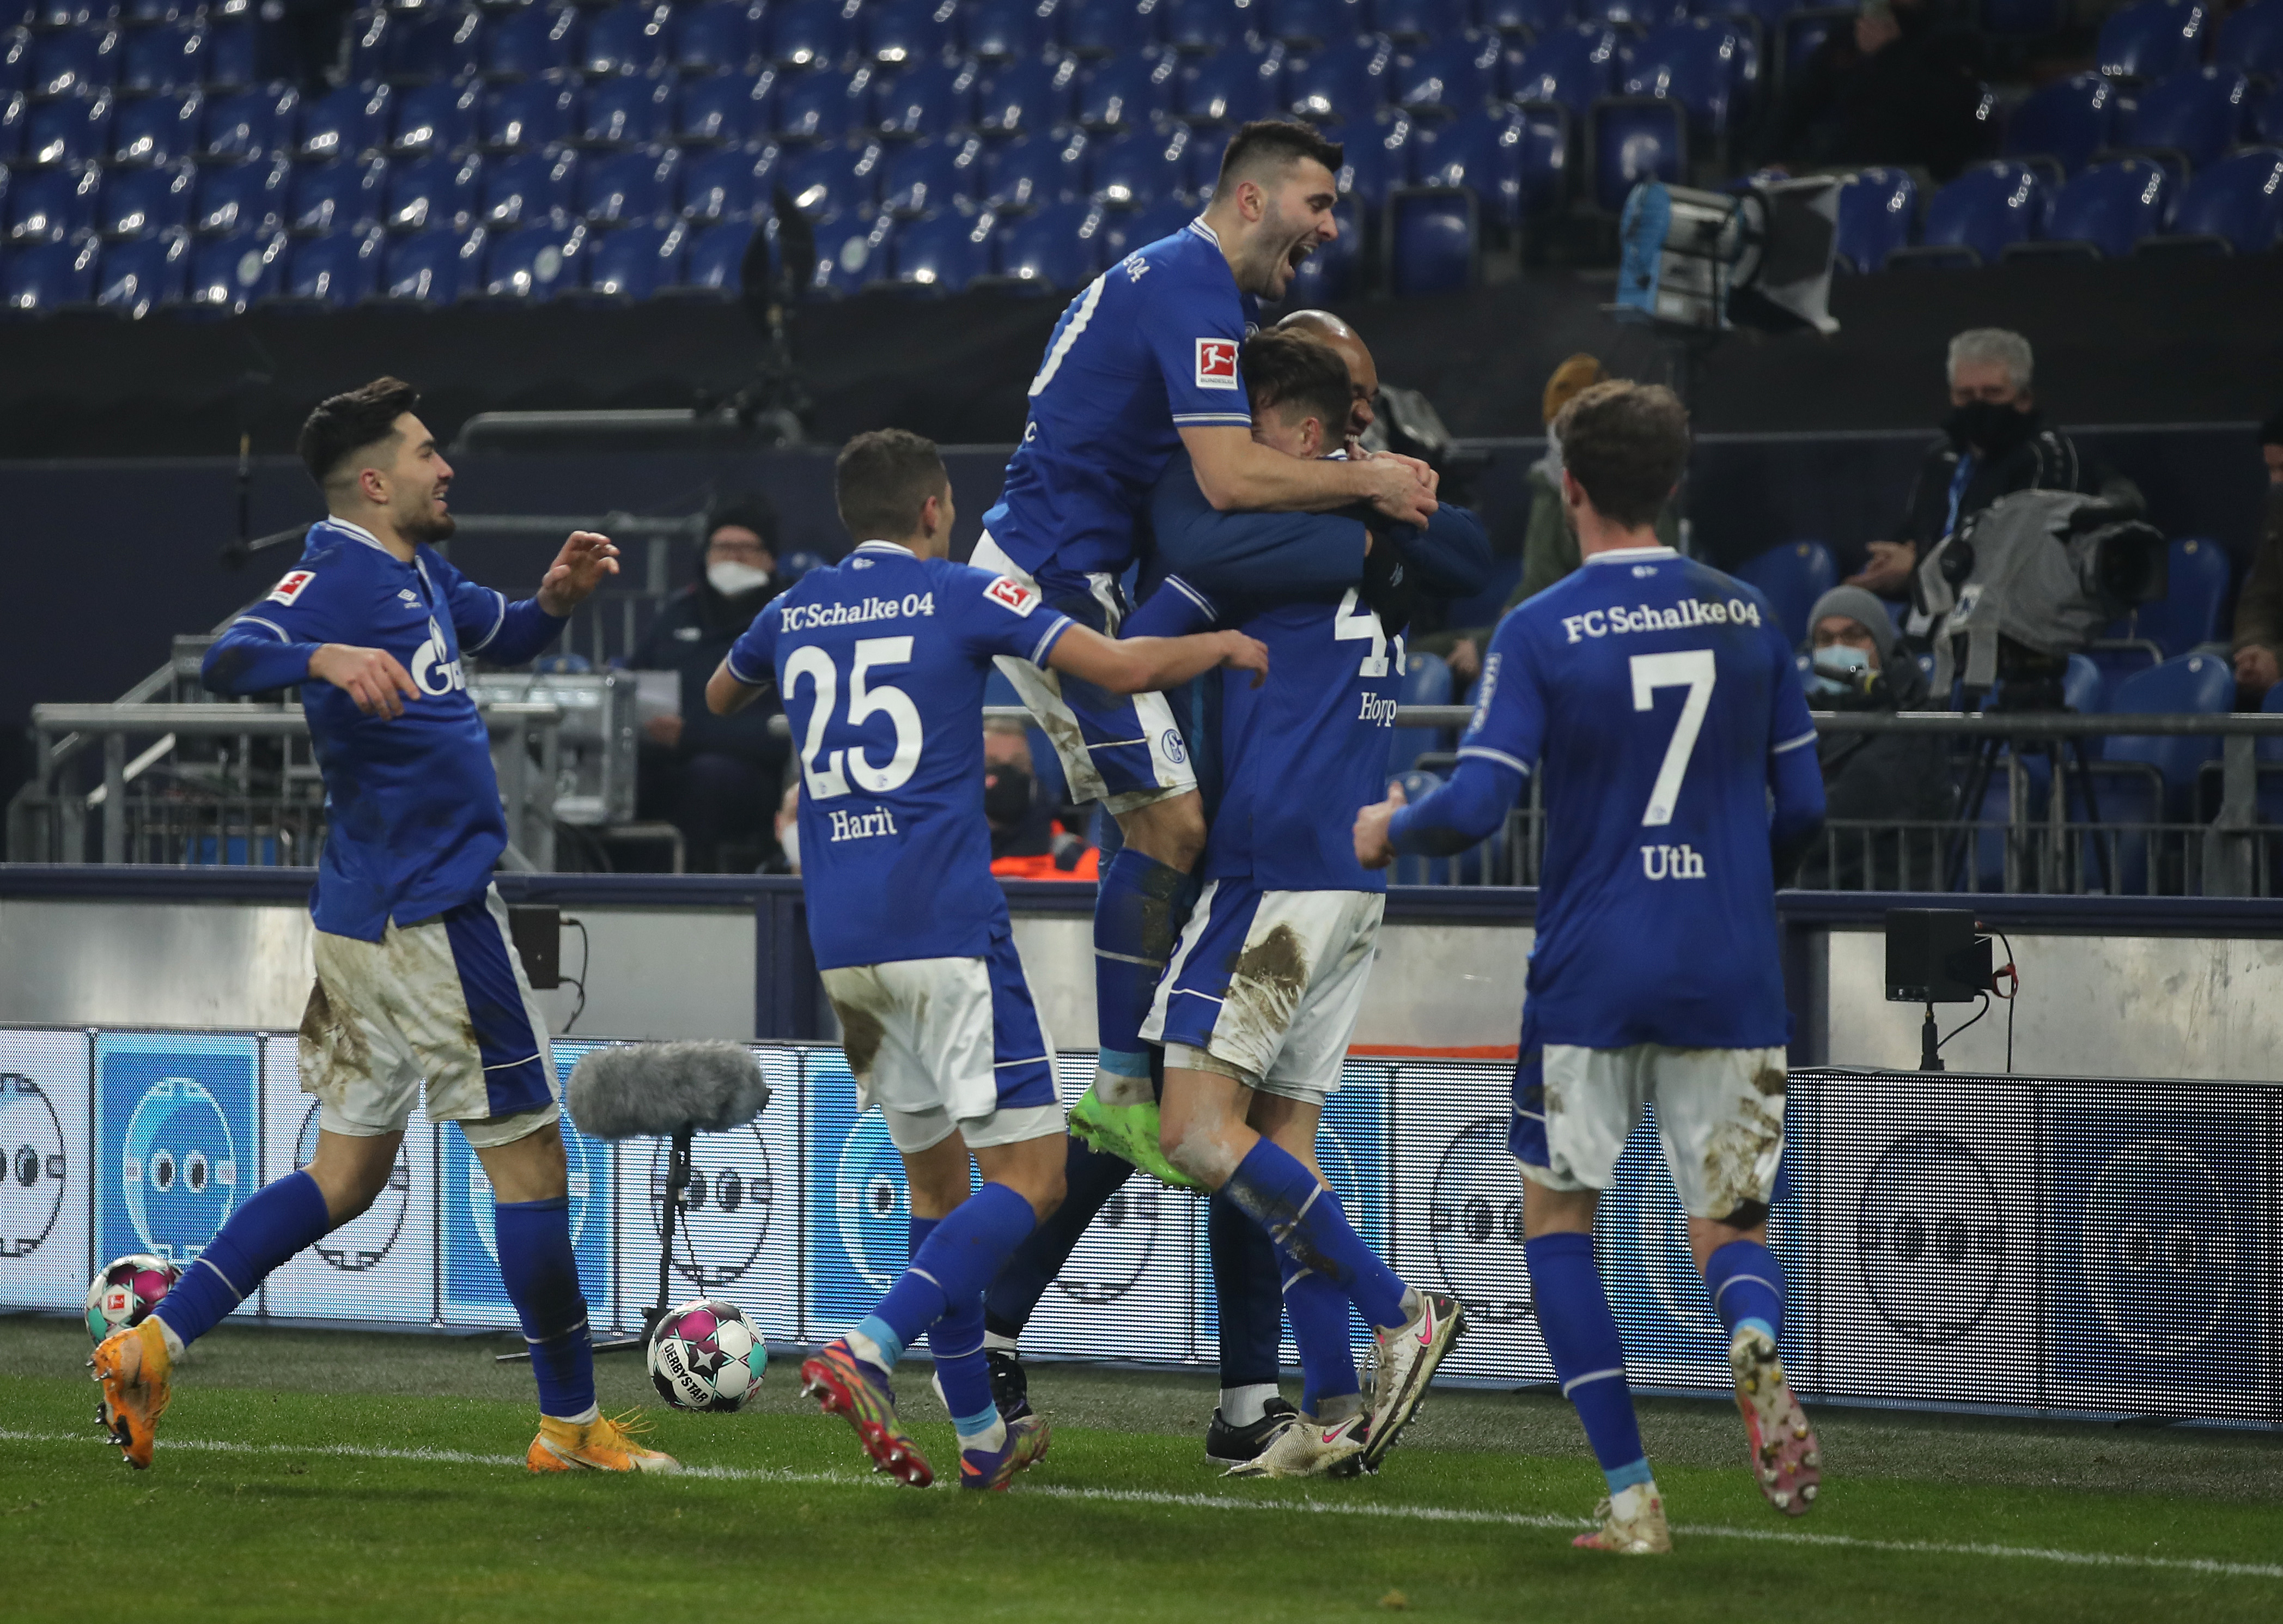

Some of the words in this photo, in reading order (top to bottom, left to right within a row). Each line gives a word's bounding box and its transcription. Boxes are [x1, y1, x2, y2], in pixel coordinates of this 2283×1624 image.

[806, 597, 900, 628] Schalke
[901, 592, 935, 617] 04
[1562, 611, 1608, 643] FC
[1608, 599, 1727, 634] Schalke
[1728, 599, 1761, 627] 04
[783, 636, 923, 800] 25
[1629, 649, 1716, 826] 7
[829, 806, 898, 842] Harit
[1641, 844, 1706, 880] Uth
[665, 1343, 708, 1402] DERBYSTAR
